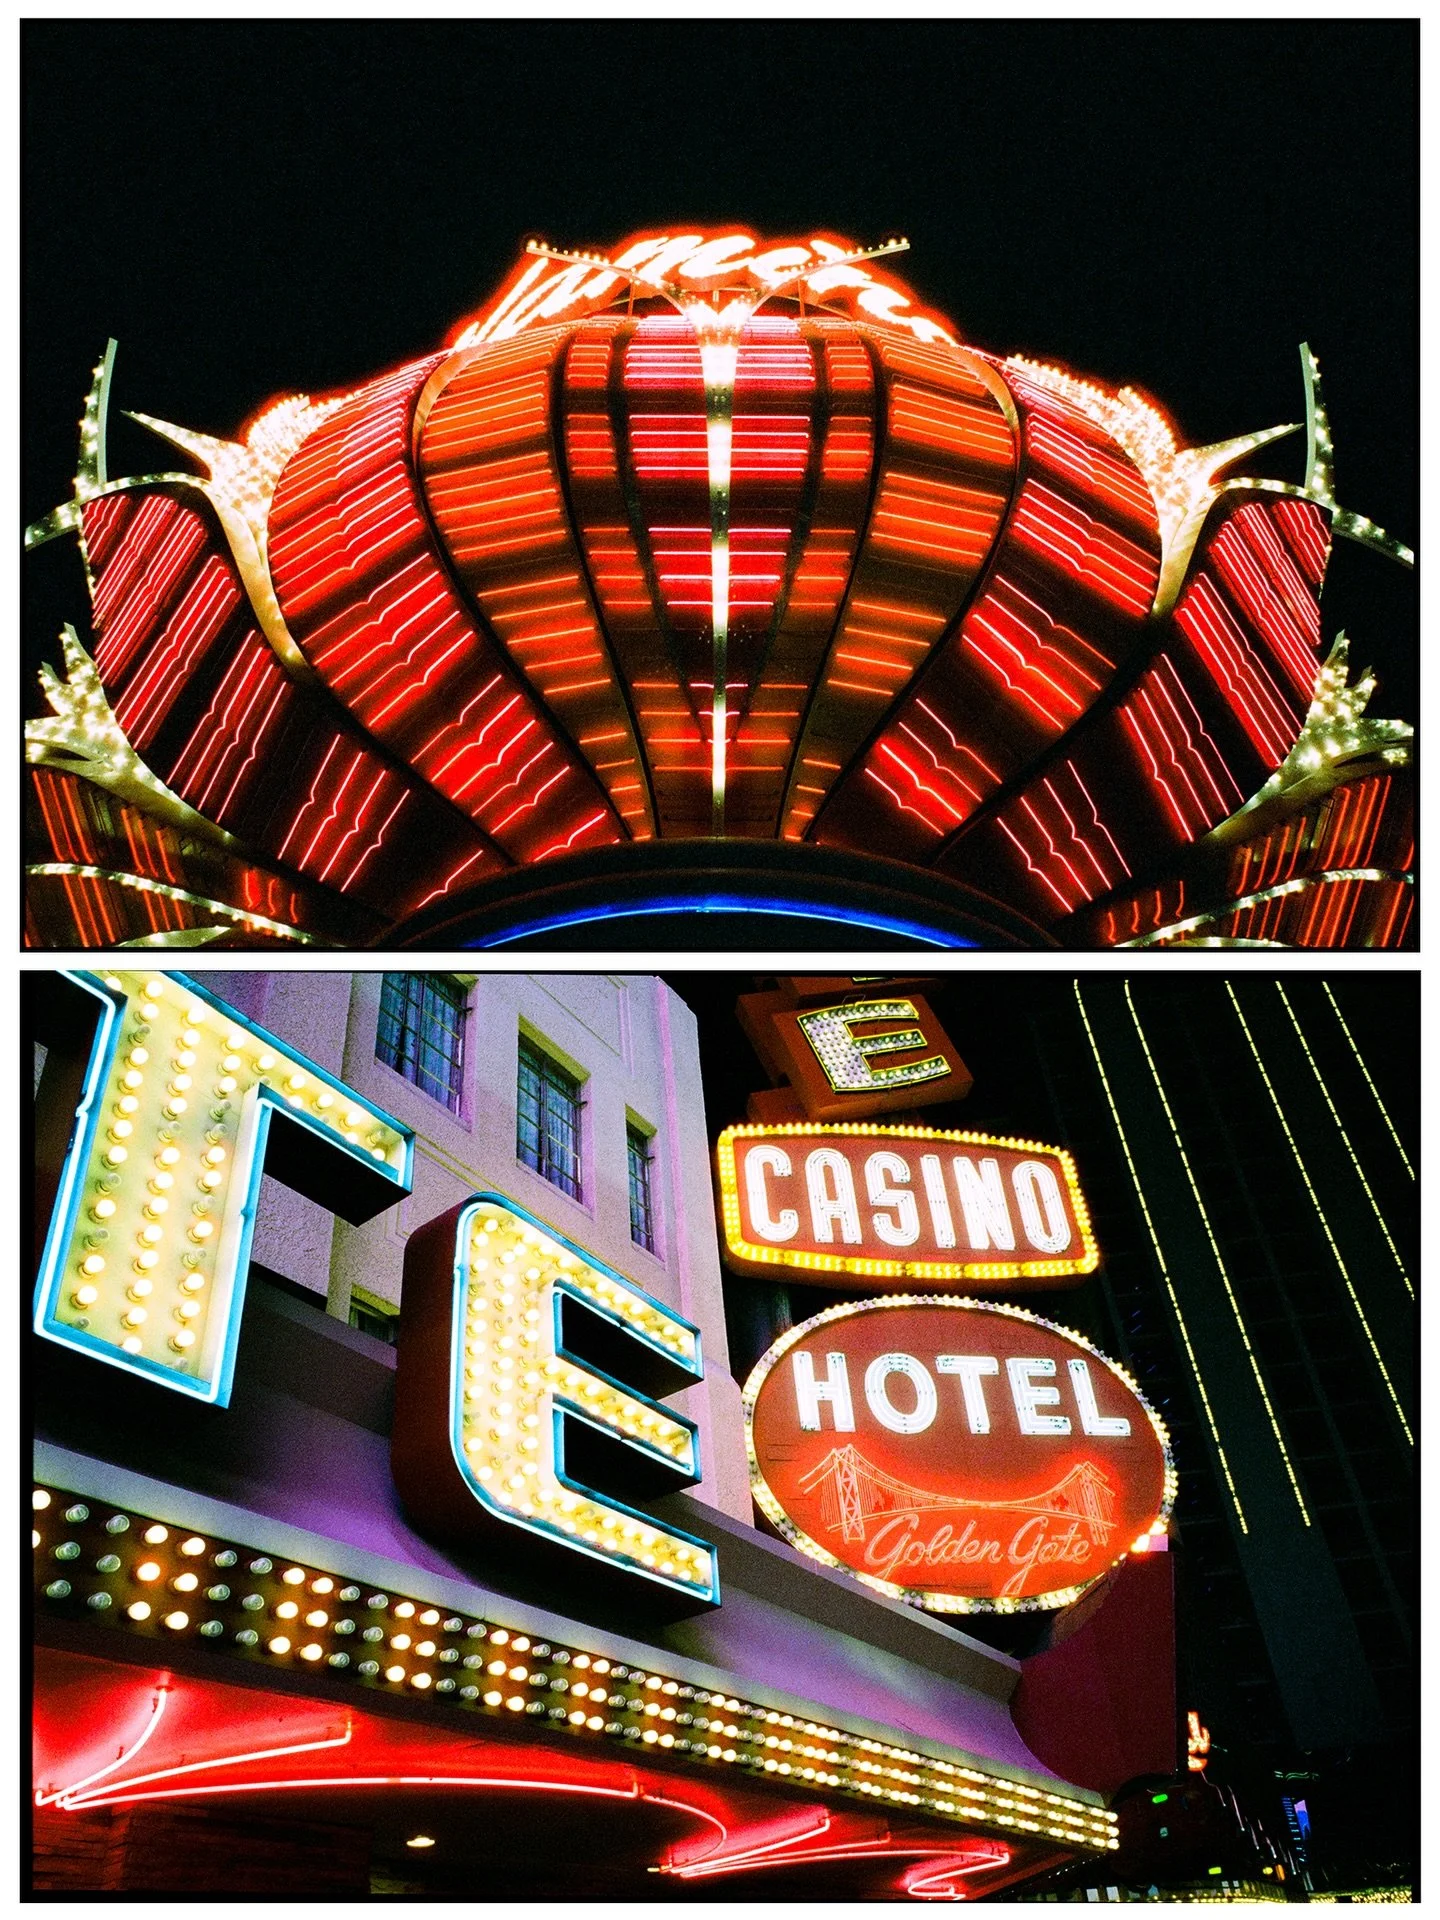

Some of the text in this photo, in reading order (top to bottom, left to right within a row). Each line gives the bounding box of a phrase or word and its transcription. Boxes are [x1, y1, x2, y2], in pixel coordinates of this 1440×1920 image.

[744, 1144, 1072, 1254] CASINO
[792, 1351, 1131, 1436] HOTEL
[863, 1512, 1093, 1597] Golden Gate
